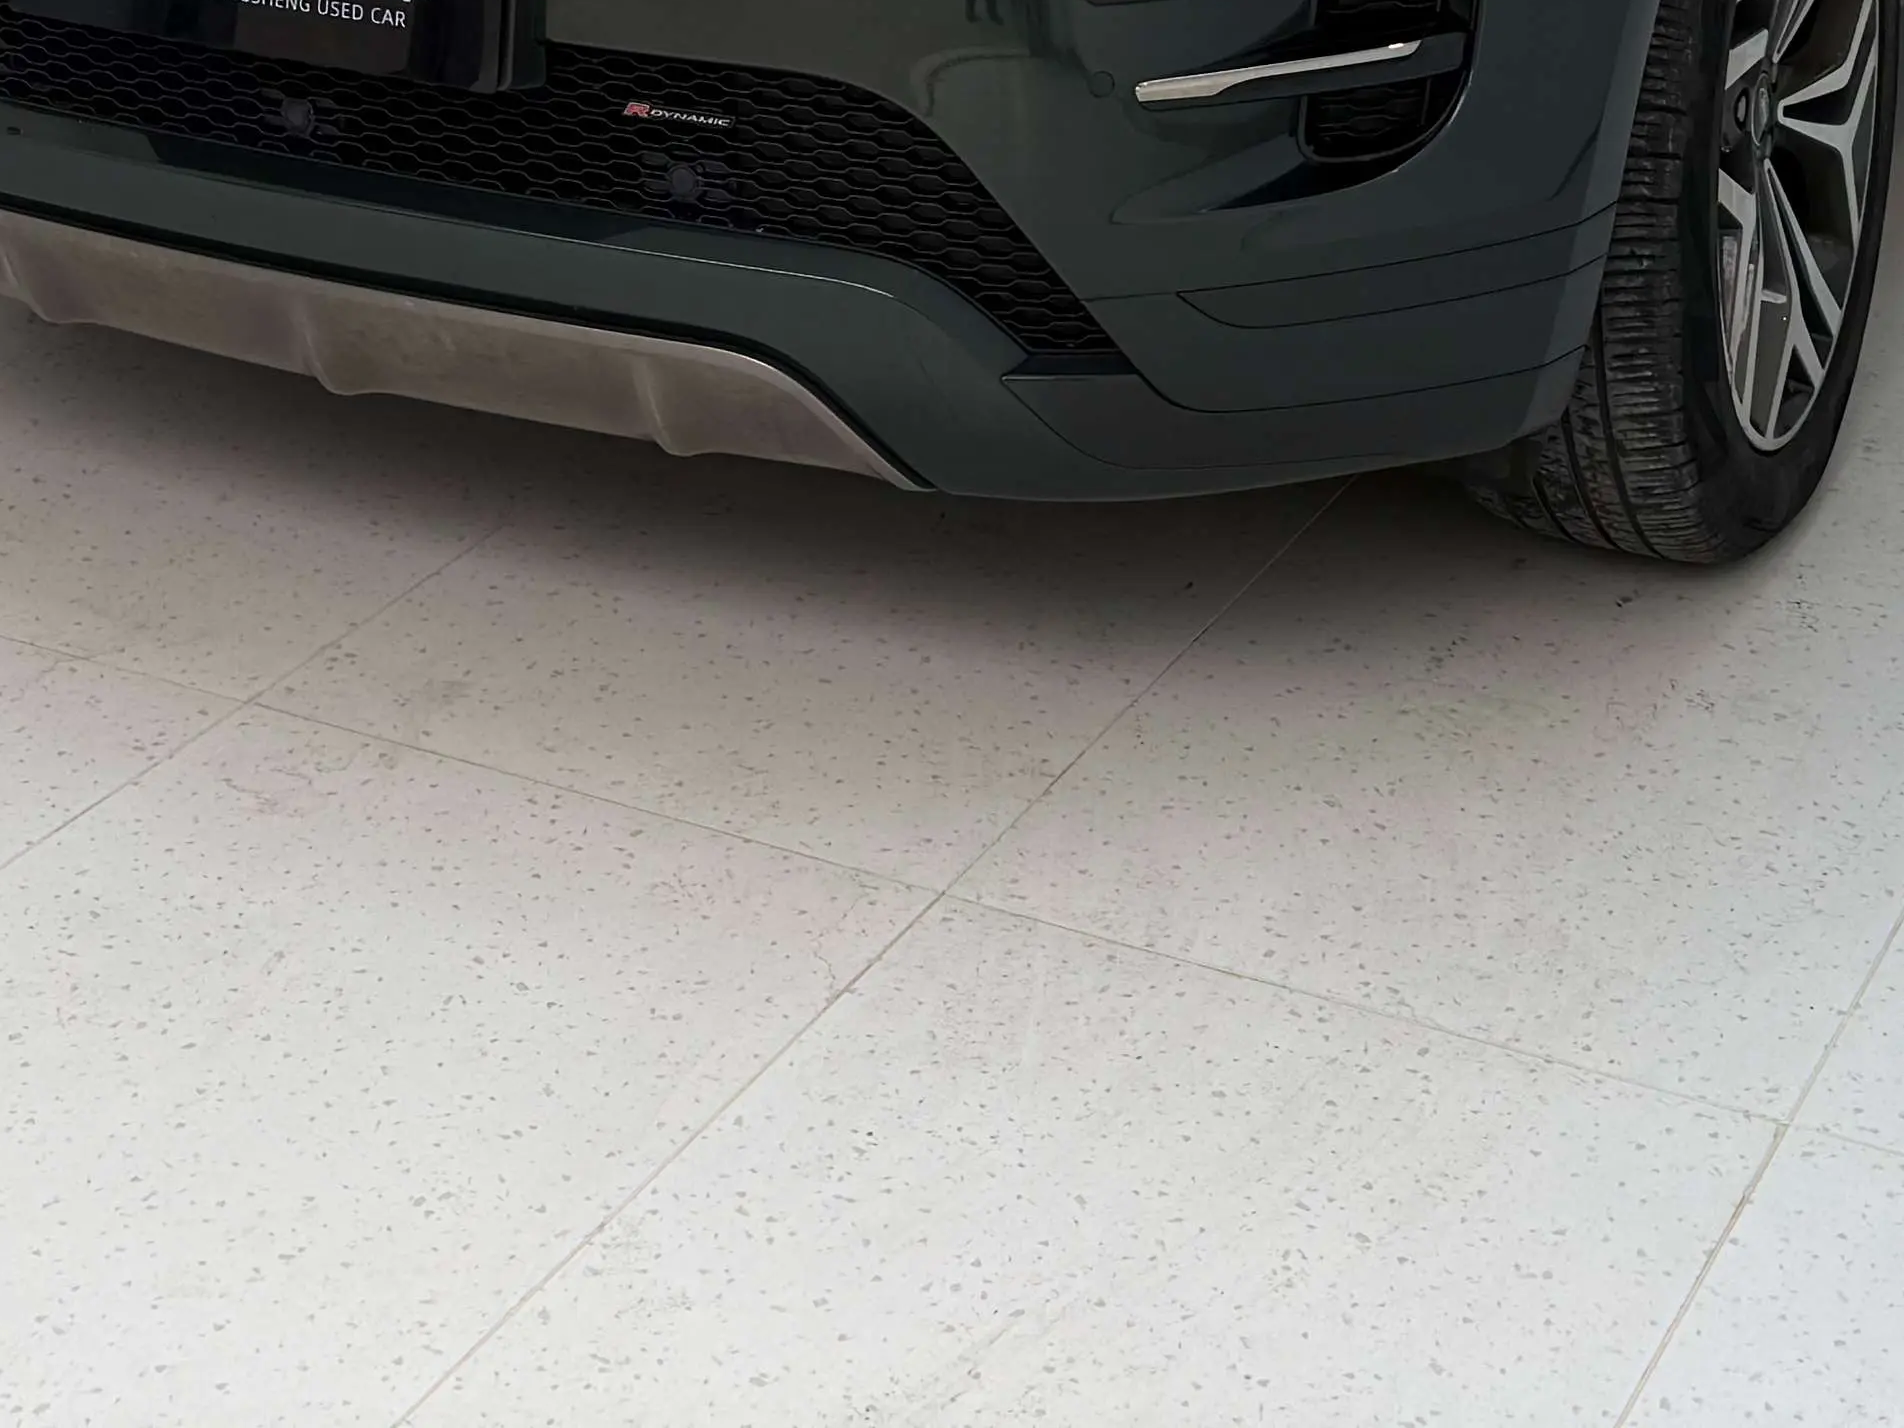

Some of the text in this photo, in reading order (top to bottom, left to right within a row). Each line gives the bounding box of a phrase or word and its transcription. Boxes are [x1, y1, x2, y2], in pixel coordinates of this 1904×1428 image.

[317, 0, 364, 22] USED
[370, 7, 407, 29] CAR
[649, 108, 731, 127] DYNAMIC
